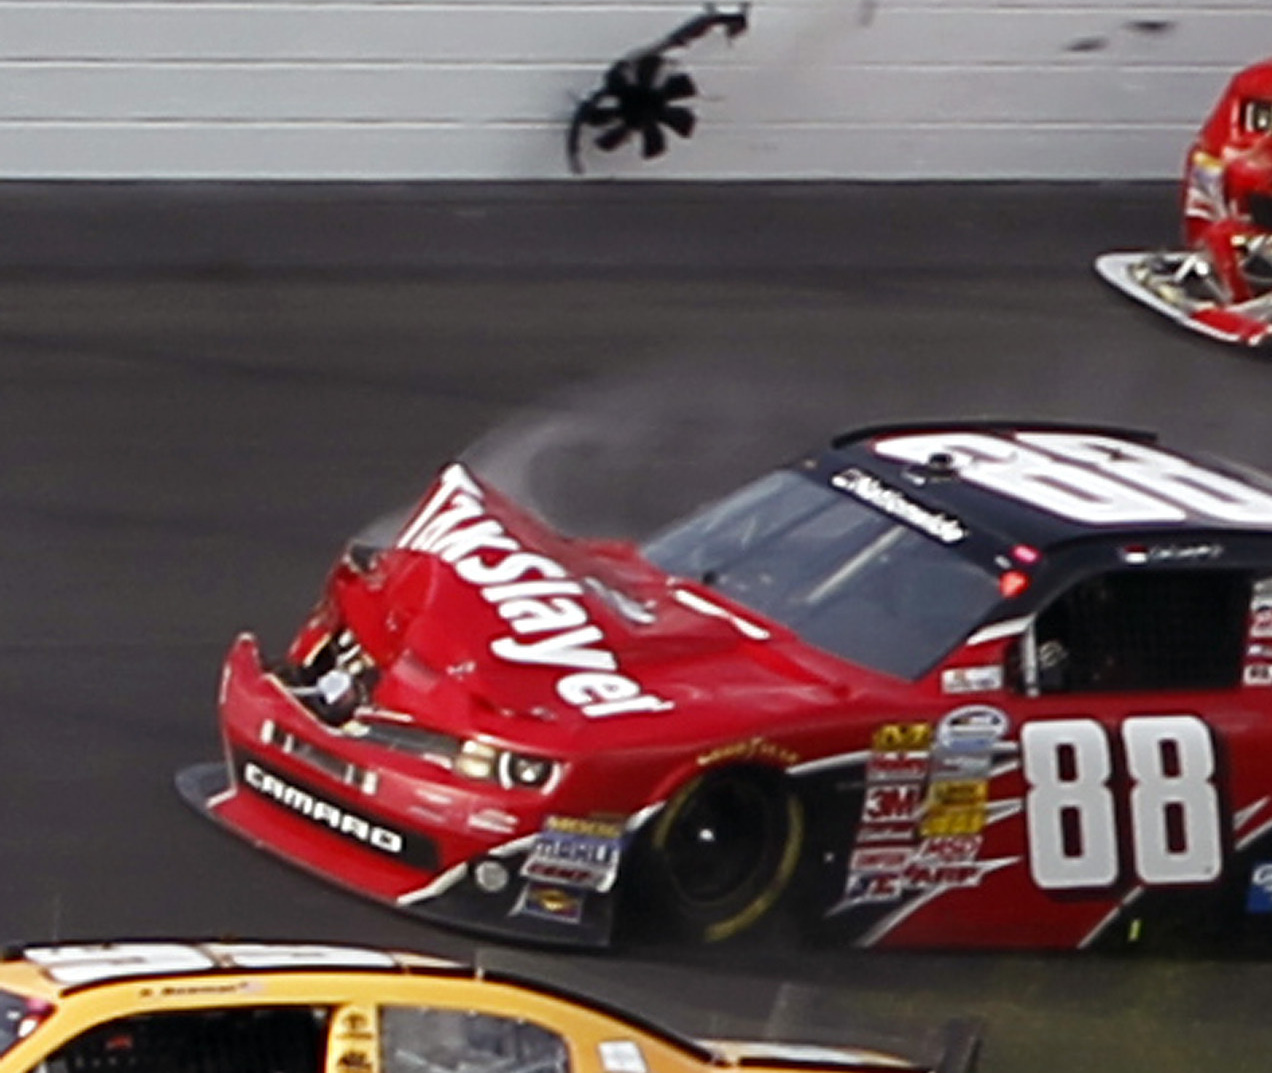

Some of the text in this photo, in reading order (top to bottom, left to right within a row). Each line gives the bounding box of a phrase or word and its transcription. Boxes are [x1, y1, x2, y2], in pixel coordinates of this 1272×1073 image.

[398, 462, 675, 719] TaxSlayer
[244, 761, 403, 853] CAMARO
[865, 786, 919, 819] 3M
[1021, 714, 1222, 889] 88
